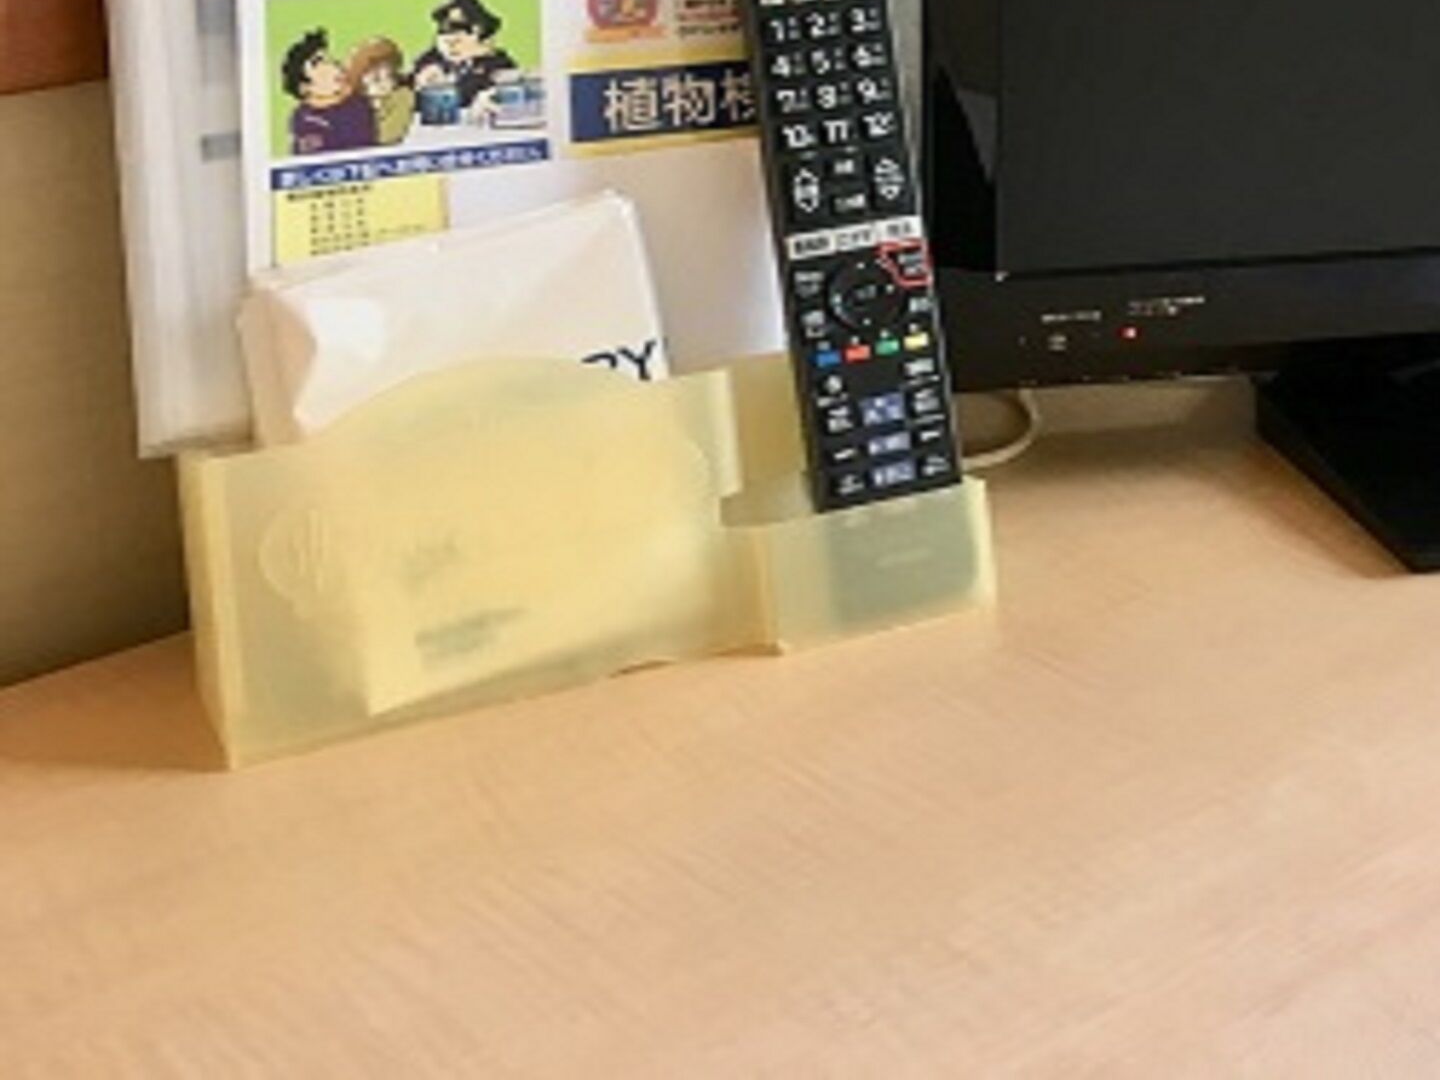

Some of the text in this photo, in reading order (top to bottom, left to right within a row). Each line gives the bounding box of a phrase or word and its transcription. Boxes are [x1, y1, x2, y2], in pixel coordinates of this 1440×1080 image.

[769, 7, 866, 42] 1 2 3
[771, 55, 791, 77] 4
[810, 50, 831, 74] 5
[857, 78, 877, 104] 9
[823, 120, 849, 143] 11
